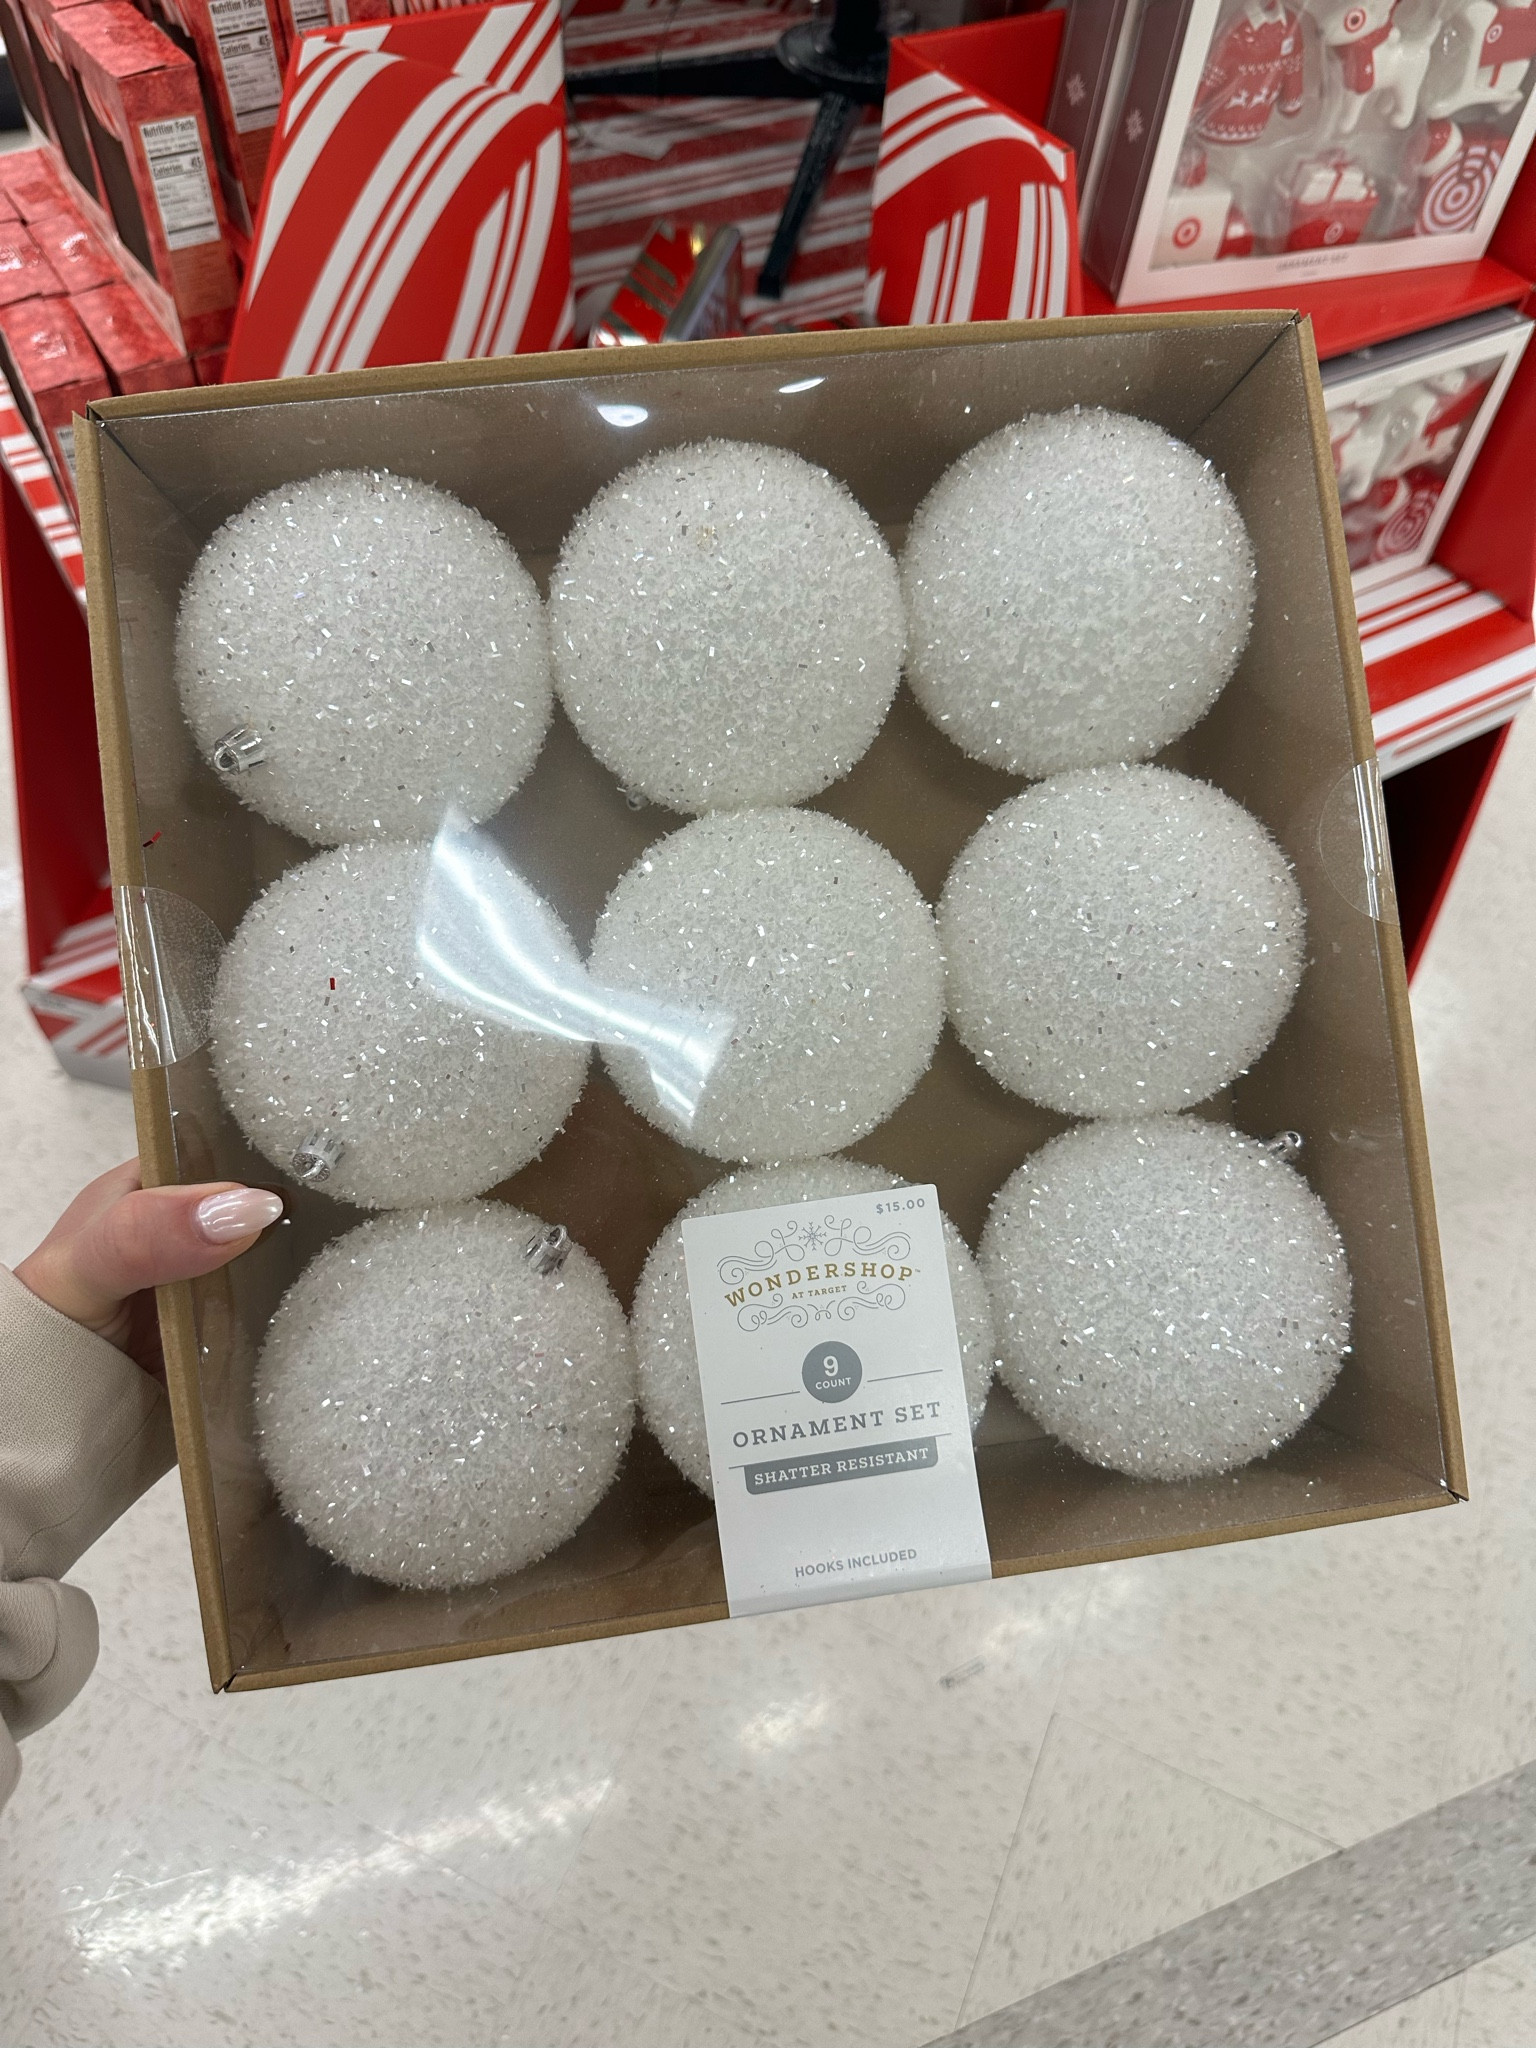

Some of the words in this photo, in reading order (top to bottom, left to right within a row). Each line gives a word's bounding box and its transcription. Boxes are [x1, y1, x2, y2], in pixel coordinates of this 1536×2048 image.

[875, 1198, 926, 1214] $15.00
[724, 1262, 913, 1307] WONDERSHOP
[791, 1291, 805, 1300] AT
[808, 1285, 848, 1297] TARGET
[822, 1355, 839, 1377] 9
[815, 1377, 852, 1390] COUNT
[733, 1409, 884, 1448] ORNAMENT
[894, 1401, 941, 1424] SET
[754, 1462, 832, 1486] SHATTER
[836, 1447, 929, 1473] RESISTANT
[795, 1560, 844, 1578] HOOKS
[847, 1548, 917, 1569] INCLUDED
